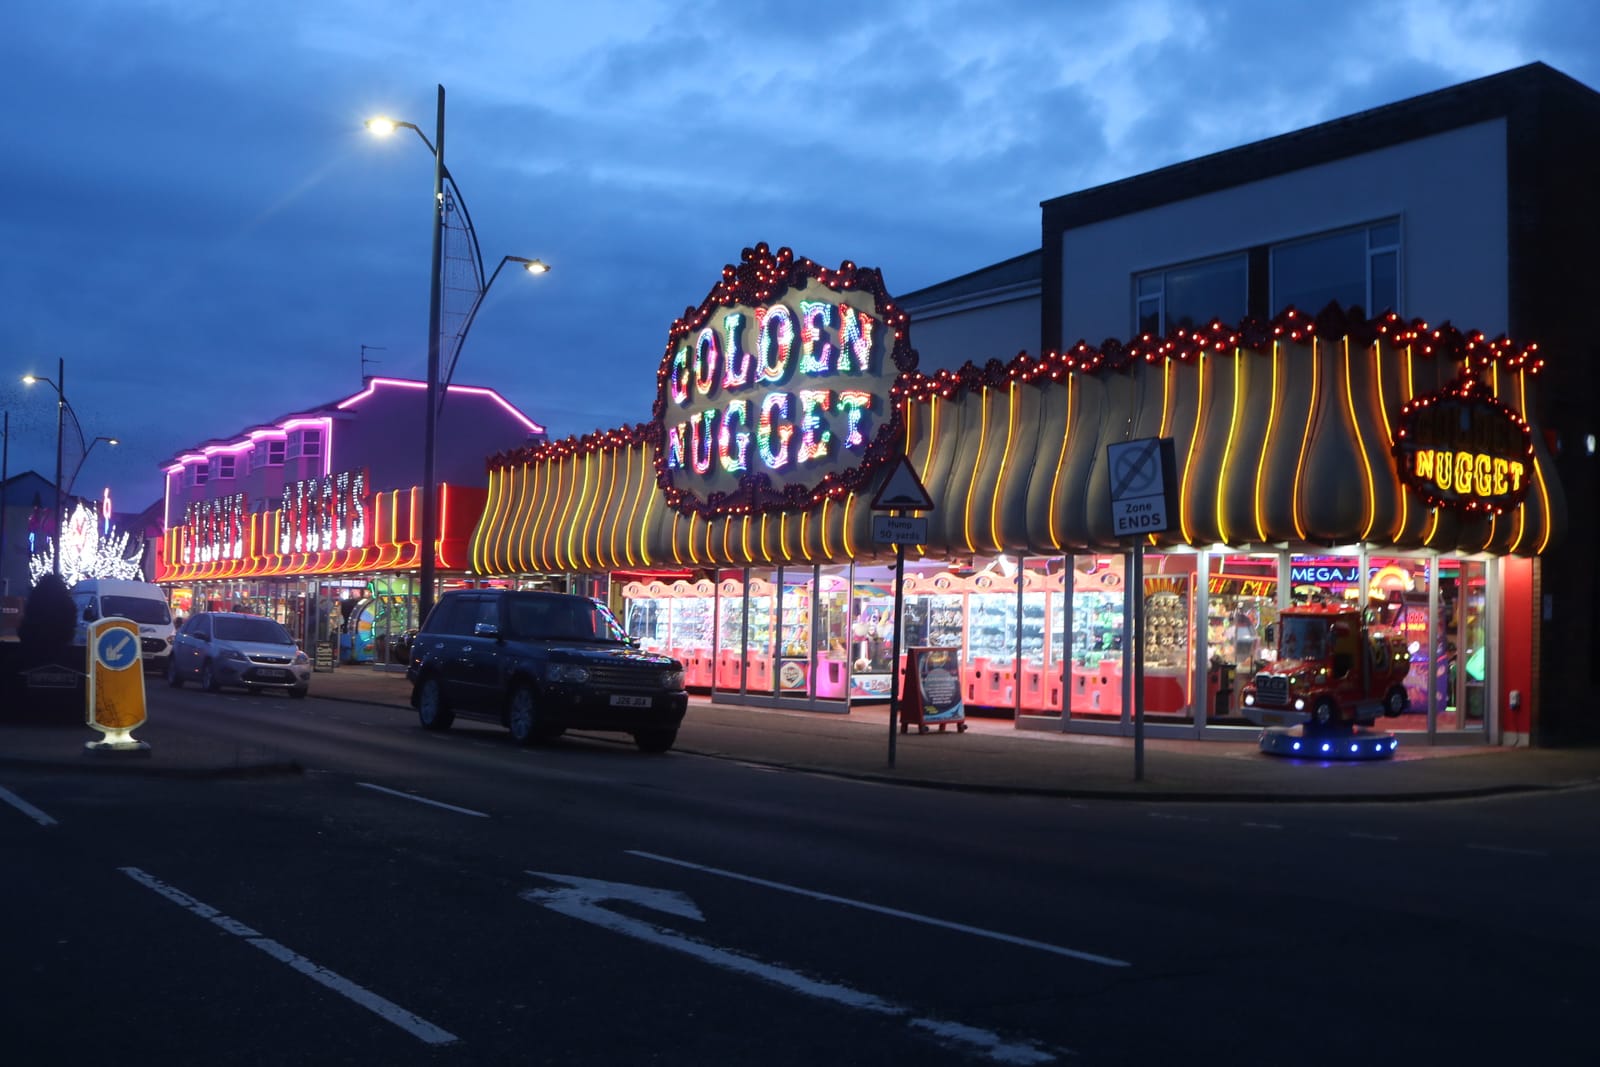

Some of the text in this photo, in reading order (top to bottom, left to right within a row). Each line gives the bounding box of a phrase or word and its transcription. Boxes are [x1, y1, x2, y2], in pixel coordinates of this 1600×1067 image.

[671, 300, 874, 404] GOLDEN
[668, 390, 872, 474] NUGGET
[1416, 450, 1524, 497] NUGGET
[1126, 503, 1152, 513] Zone
[887, 519, 912, 530] Hump
[1119, 513, 1161, 530] ENDS
[1291, 567, 1343, 582] MEGA
